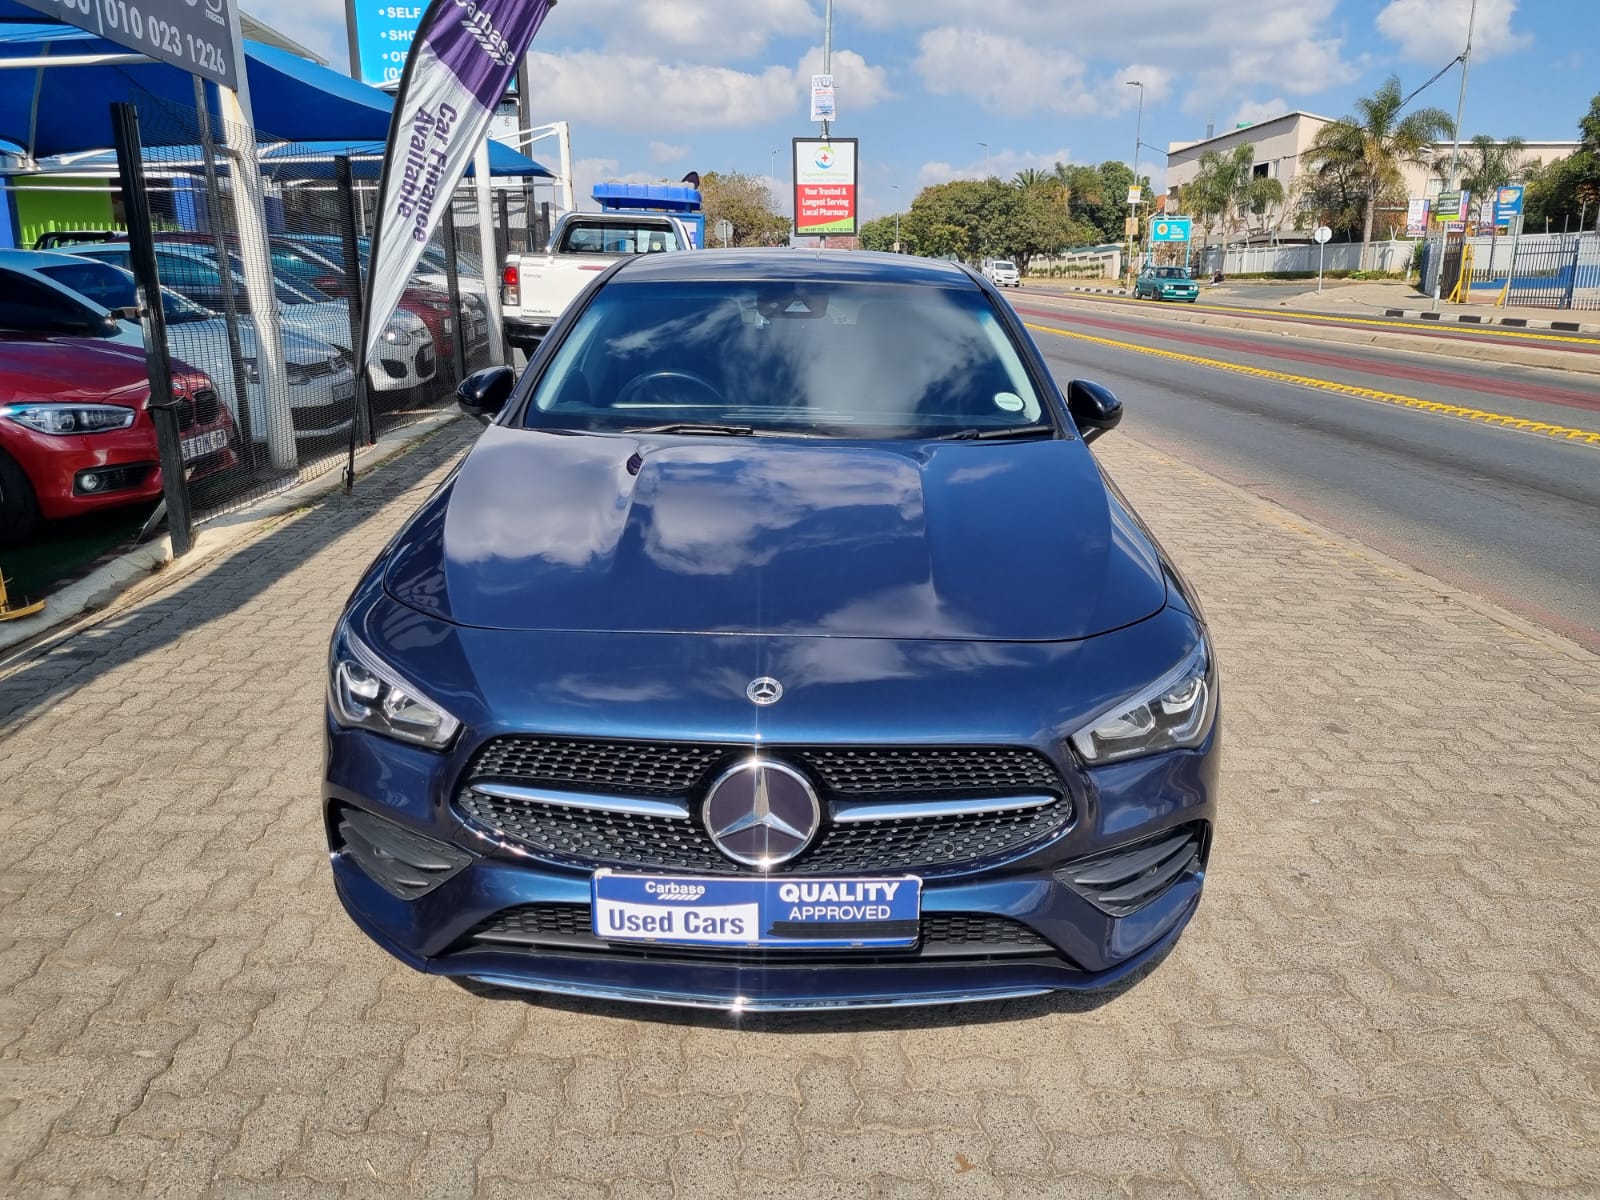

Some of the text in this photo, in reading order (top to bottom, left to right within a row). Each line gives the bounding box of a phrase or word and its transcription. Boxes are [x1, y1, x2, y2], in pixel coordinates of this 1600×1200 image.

[387, 7, 421, 19] SELF
[105, 0, 226, 76] 010 023 1226
[397, 106, 436, 219] Available
[412, 102, 458, 243] Car Finance
[804, 187, 818, 196] Your
[818, 187, 841, 196] Trusted
[802, 197, 849, 208] Longest Serving
[802, 208, 849, 218] Local Pharmacy
[644, 881, 706, 896] Carbase
[779, 882, 901, 903] QUALITY
[788, 905, 892, 921] APPROVED
[608, 908, 745, 936] Used Cars
